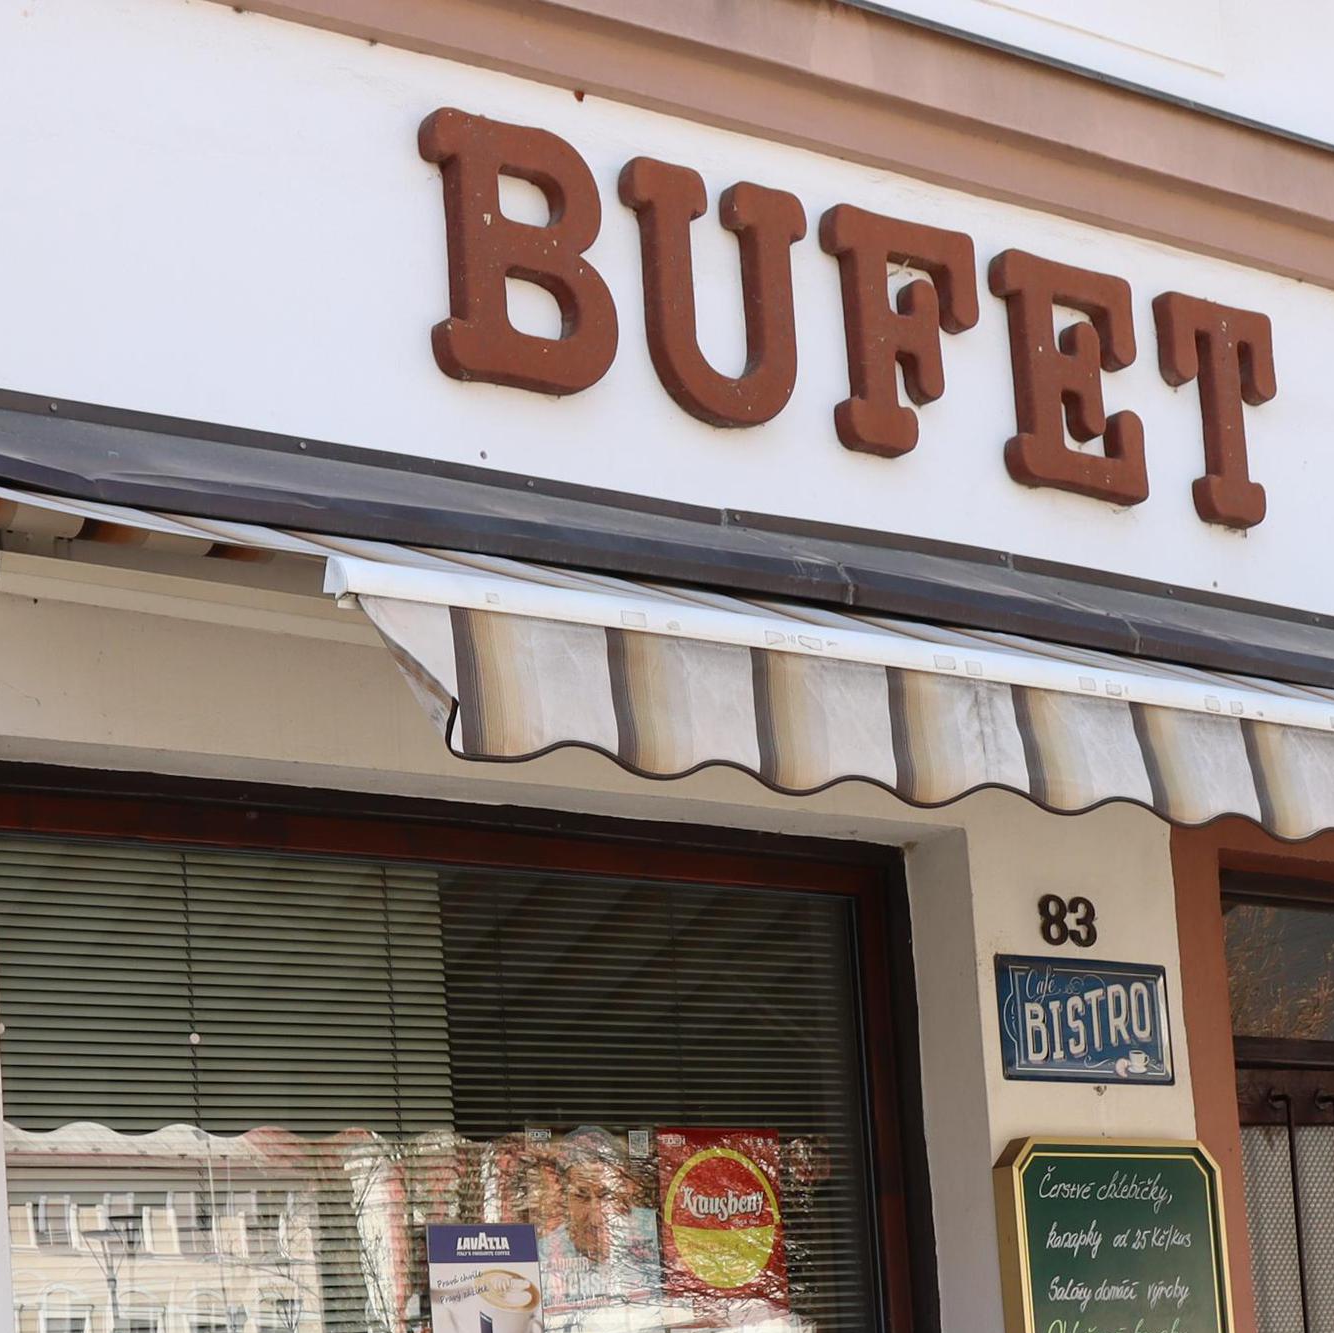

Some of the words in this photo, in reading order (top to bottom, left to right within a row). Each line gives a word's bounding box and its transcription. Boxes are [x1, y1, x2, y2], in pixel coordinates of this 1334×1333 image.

[418, 106, 1278, 530] BUFET
[1038, 894, 1097, 947] 83
[1025, 964, 1058, 1005] Café
[1024, 981, 1153, 1064] BISTRO
[1039, 1166, 1095, 1200] Čerstvé
[456, 1232, 510, 1250] LAVAZZA
[1112, 1228, 1131, 1248] od
[1131, 1228, 1151, 1250] 25
[1094, 1278, 1140, 1301] domácí
[1147, 1275, 1190, 1310] výroby
